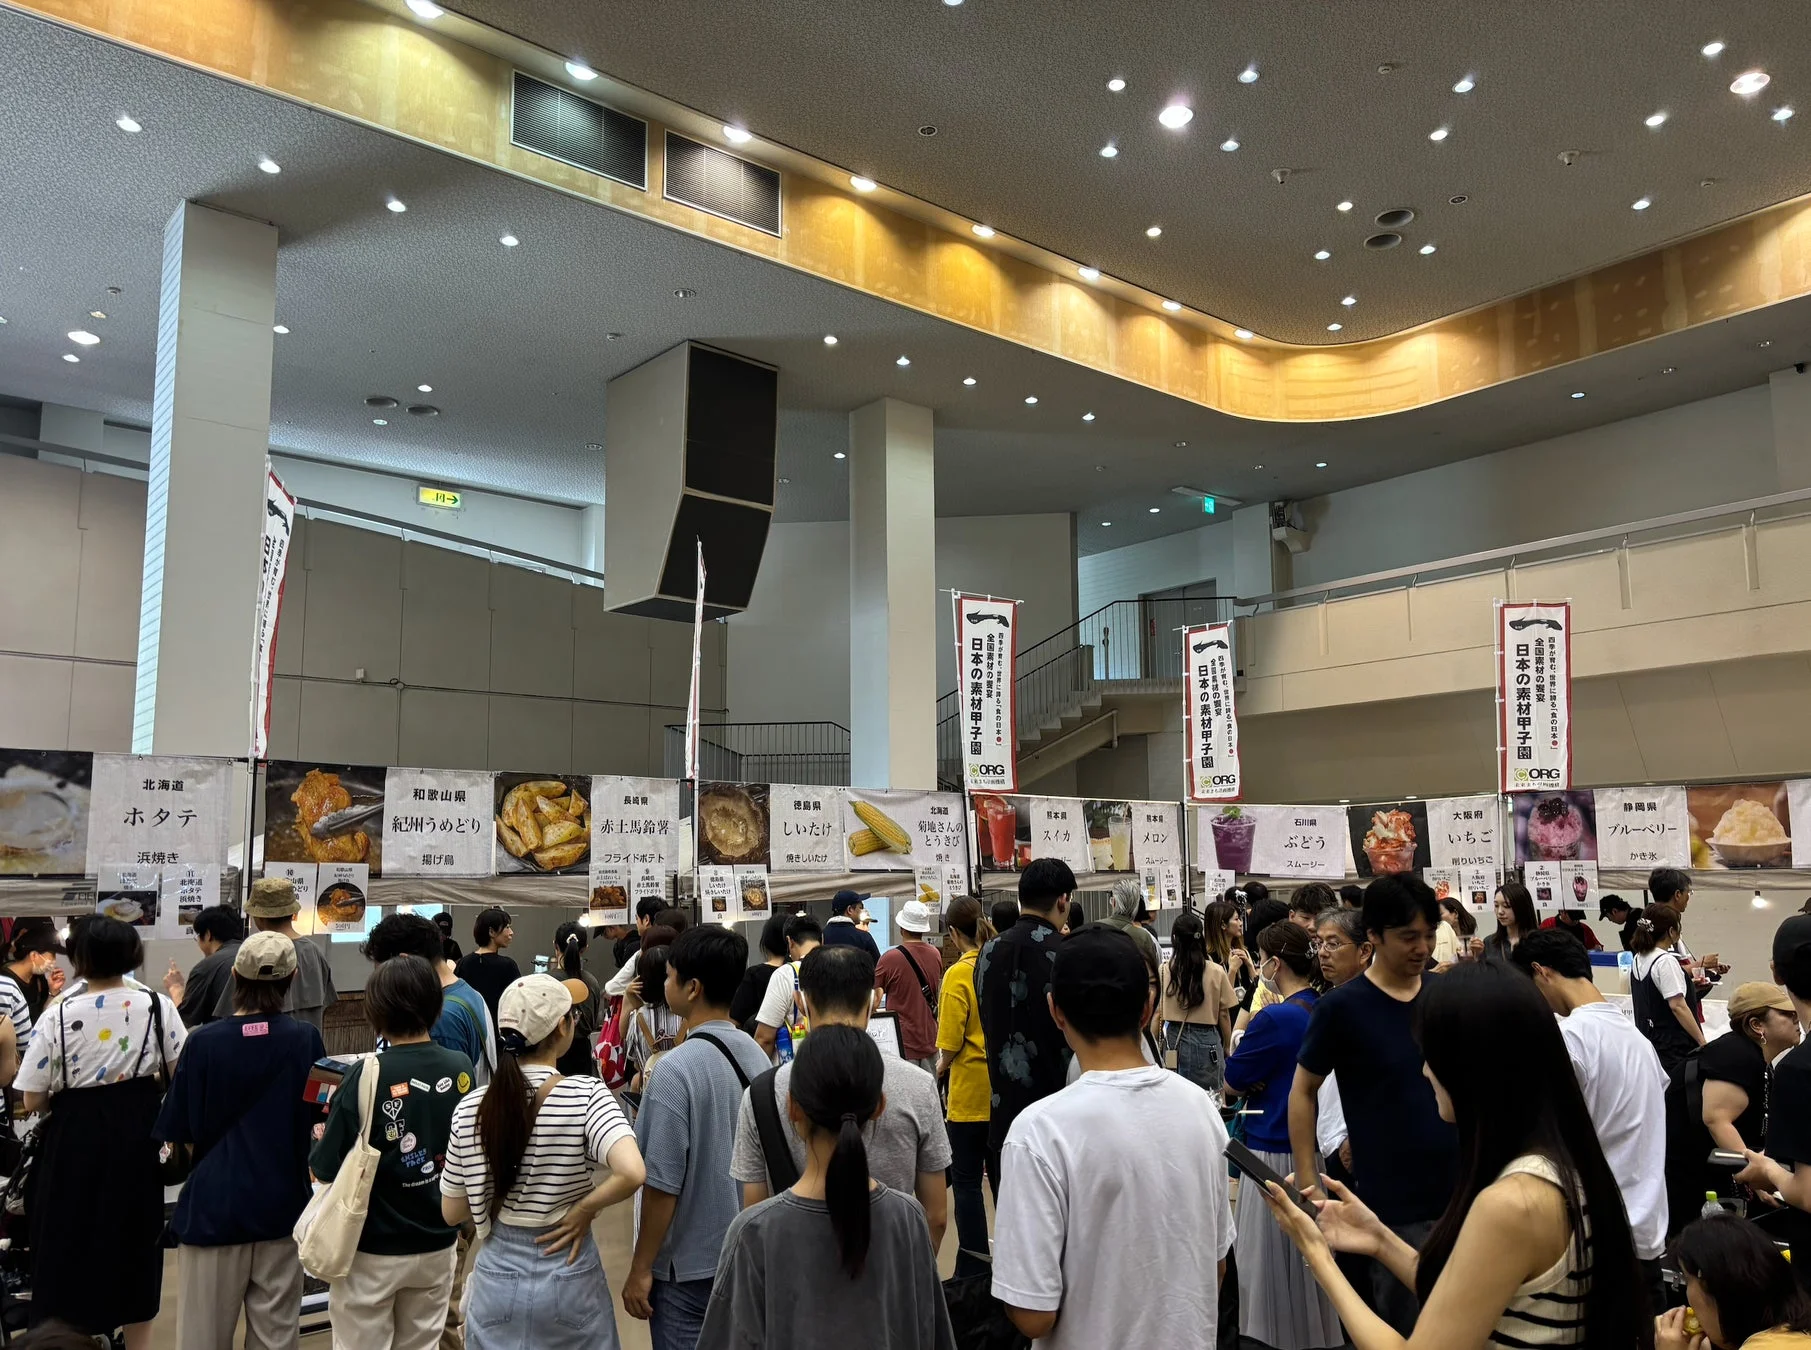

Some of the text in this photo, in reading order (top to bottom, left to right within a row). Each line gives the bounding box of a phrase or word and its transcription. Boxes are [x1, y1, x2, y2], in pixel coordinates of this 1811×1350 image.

[970, 637, 983, 756] 日本の素材甲子園
[1516, 643, 1532, 760] 日本の素材甲子園
[1198, 664, 1214, 769] 日本の素材甲子園
[979, 764, 1005, 776] ORG
[1529, 768, 1560, 780] ORG
[143, 779, 183, 791] 北海道
[1212, 774, 1236, 786] ORG
[413, 789, 465, 802] 和歌山県
[624, 796, 648, 805] 長崎県
[794, 800, 821, 810] 徳島県
[931, 806, 948, 815] 北海道
[1624, 802, 1656, 812] 静岡県
[124, 808, 197, 827] ホタテ
[1047, 811, 1066, 819] 熊本県
[1453, 810, 1482, 820] 大阪府
[392, 816, 480, 833] 紀州うめどり
[601, 819, 668, 834] 赤土馬鈴薯
[784, 822, 832, 836] しいたけ
[918, 821, 964, 833] 菊地さんの
[1608, 824, 1676, 835] ブルーベリー
[925, 835, 961, 847] とうきび
[1044, 830, 1070, 841] スイカ
[1144, 833, 1167, 843] メロン
[1449, 830, 1493, 844] いちご
[1284, 836, 1325, 849] ぶどう
[137, 852, 178, 864] 浜焼き
[605, 854, 664, 863] フライドポテト
[787, 854, 827, 862] 焼きしいたけ
[936, 854, 949, 862] 焼き
[1452, 856, 1493, 865] 削りいちご
[1631, 852, 1657, 860] かき氷
